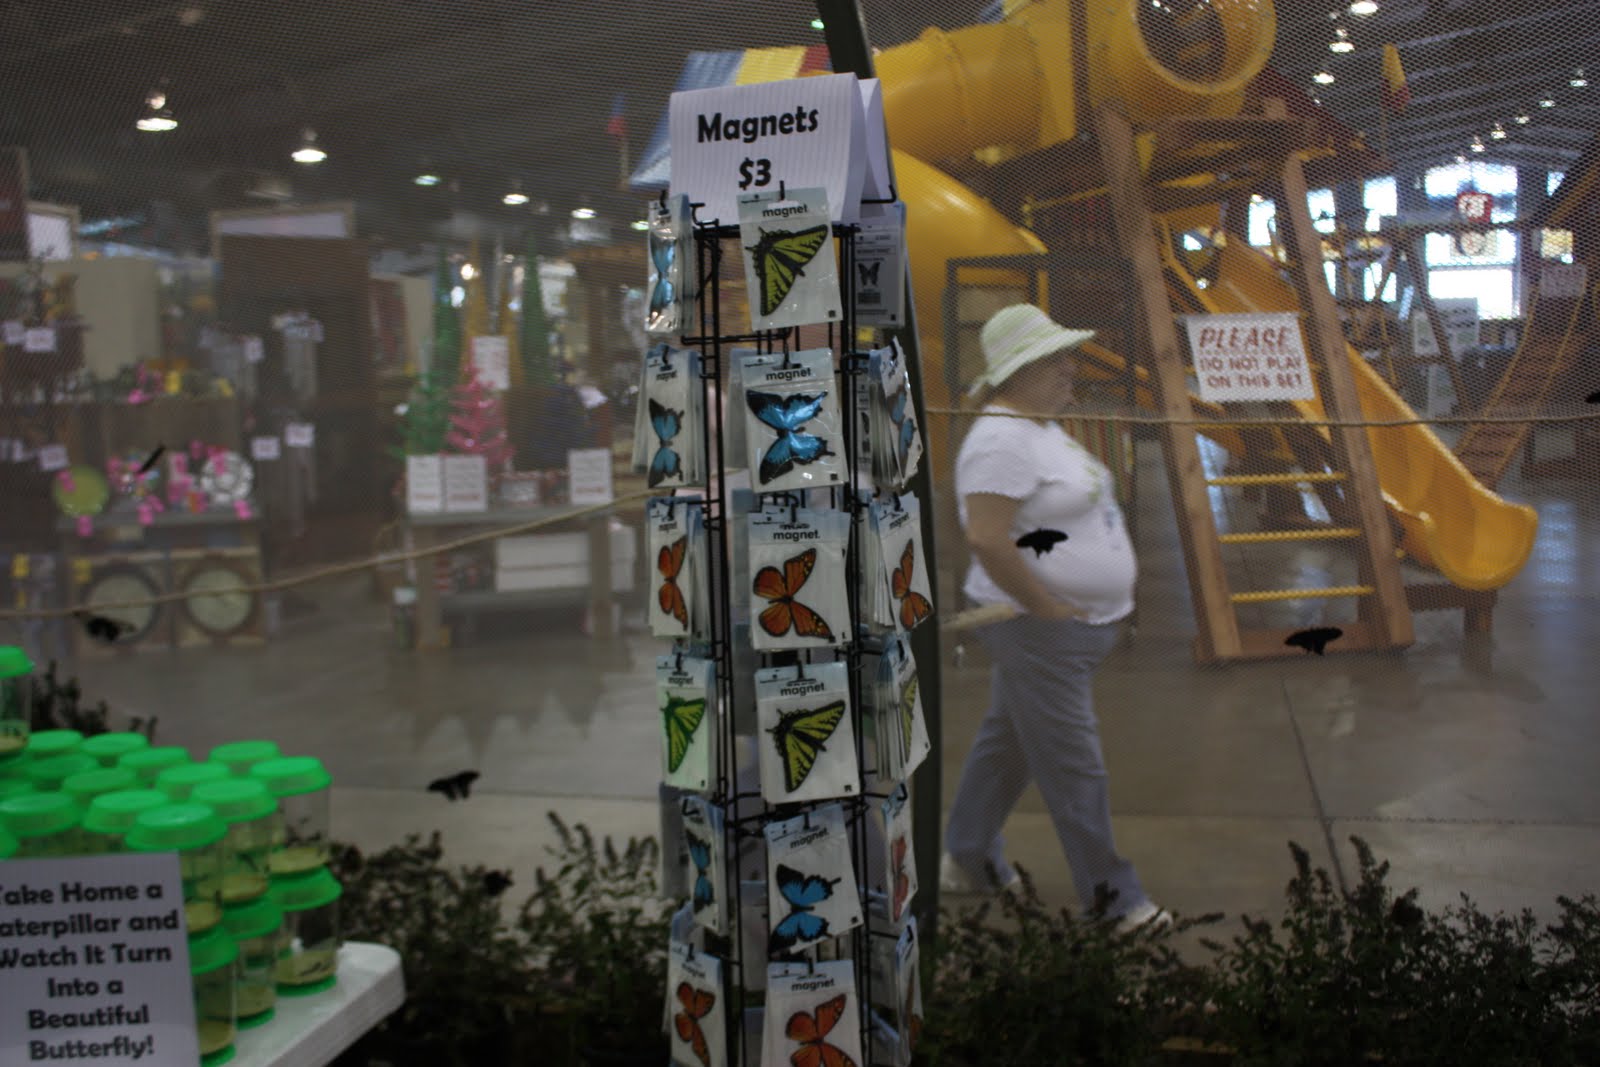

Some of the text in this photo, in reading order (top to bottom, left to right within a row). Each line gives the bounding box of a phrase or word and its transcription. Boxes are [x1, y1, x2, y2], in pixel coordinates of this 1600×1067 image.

[697, 106, 819, 143] Magnets
[738, 157, 772, 190] $3
[762, 203, 808, 218] magnet
[1199, 326, 1290, 350] PLEASE
[766, 367, 812, 381] magnet
[773, 530, 819, 542] magnet
[780, 682, 825, 697] magnet
[0, 881, 163, 905] ake Home a
[0, 909, 179, 939] aterpillar and
[0, 942, 172, 969] Watch It Turn
[48, 977, 123, 999] Into a
[791, 977, 835, 992] magnet
[28, 1003, 150, 1030] Beautiful
[29, 1035, 154, 1062] Butterfly!
